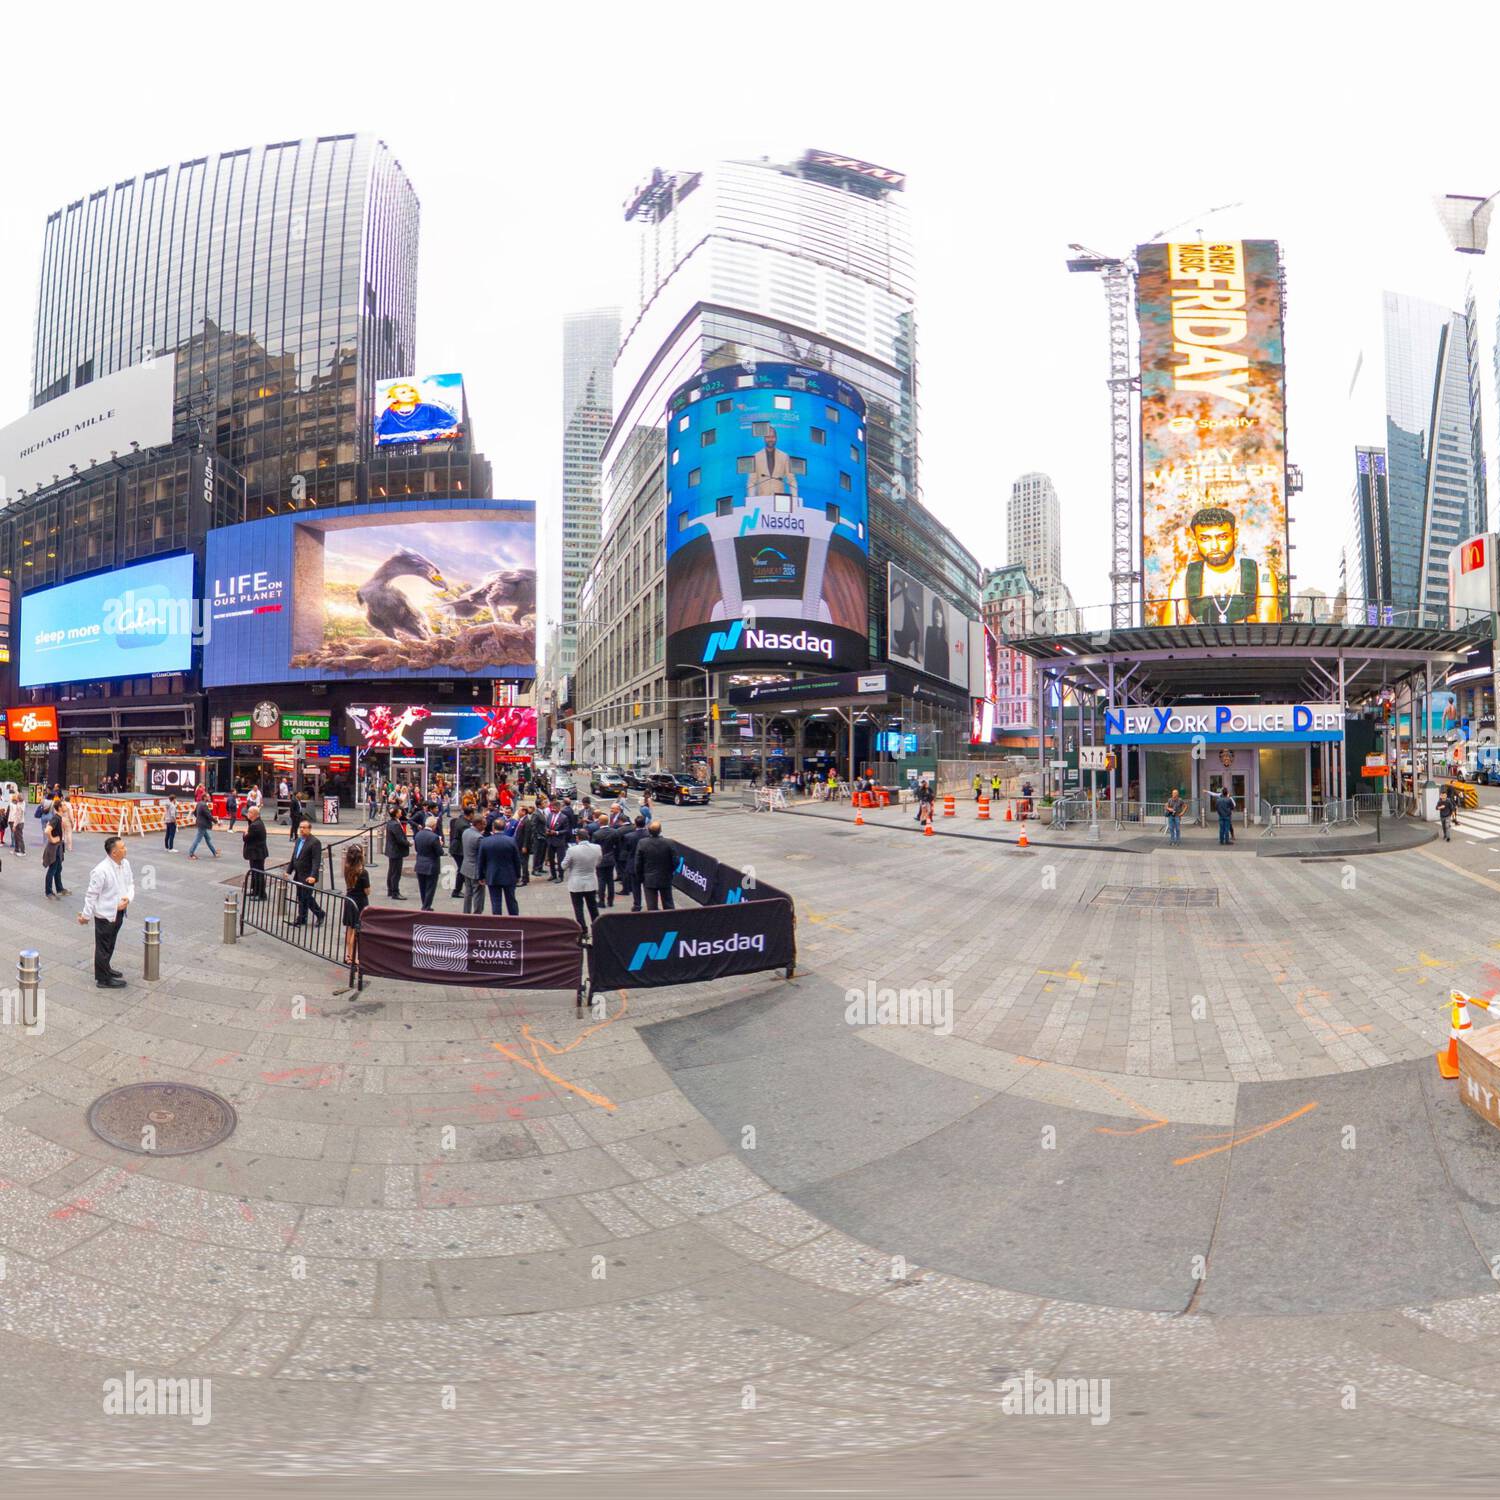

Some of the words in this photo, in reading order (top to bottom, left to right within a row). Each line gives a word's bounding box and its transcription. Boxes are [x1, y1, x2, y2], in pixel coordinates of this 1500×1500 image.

[1178, 244, 1206, 273] MUSIC
[1209, 252, 1236, 275] NEW
[1170, 275, 1251, 407] FRIDAY
[20, 428, 70, 459] RICHARD
[74, 409, 116, 433] MILLE
[1199, 417, 1255, 429] Spotify
[203, 456, 214, 504] 1500
[761, 513, 805, 533] Nasdaq
[215, 572, 268, 598] LIFE
[267, 581, 283, 590] ON
[214, 597, 236, 607] OUR
[240, 590, 283, 602] PLANET
[35, 630, 65, 646] sleep
[67, 623, 101, 640] more
[746, 629, 833, 660] Nasdaq
[283, 719, 329, 728] STARBUCKS
[291, 728, 320, 736] COFFEE
[1105, 710, 1150, 735] NEW
[1154, 708, 1209, 735] YORK
[1215, 706, 1284, 733] POLICE
[1293, 706, 1346, 733] DEPT
[682, 863, 708, 892] Nasdaq
[472, 948, 517, 961] SQUARE
[476, 939, 513, 950] TIMES
[678, 932, 765, 959] Nasdaq
